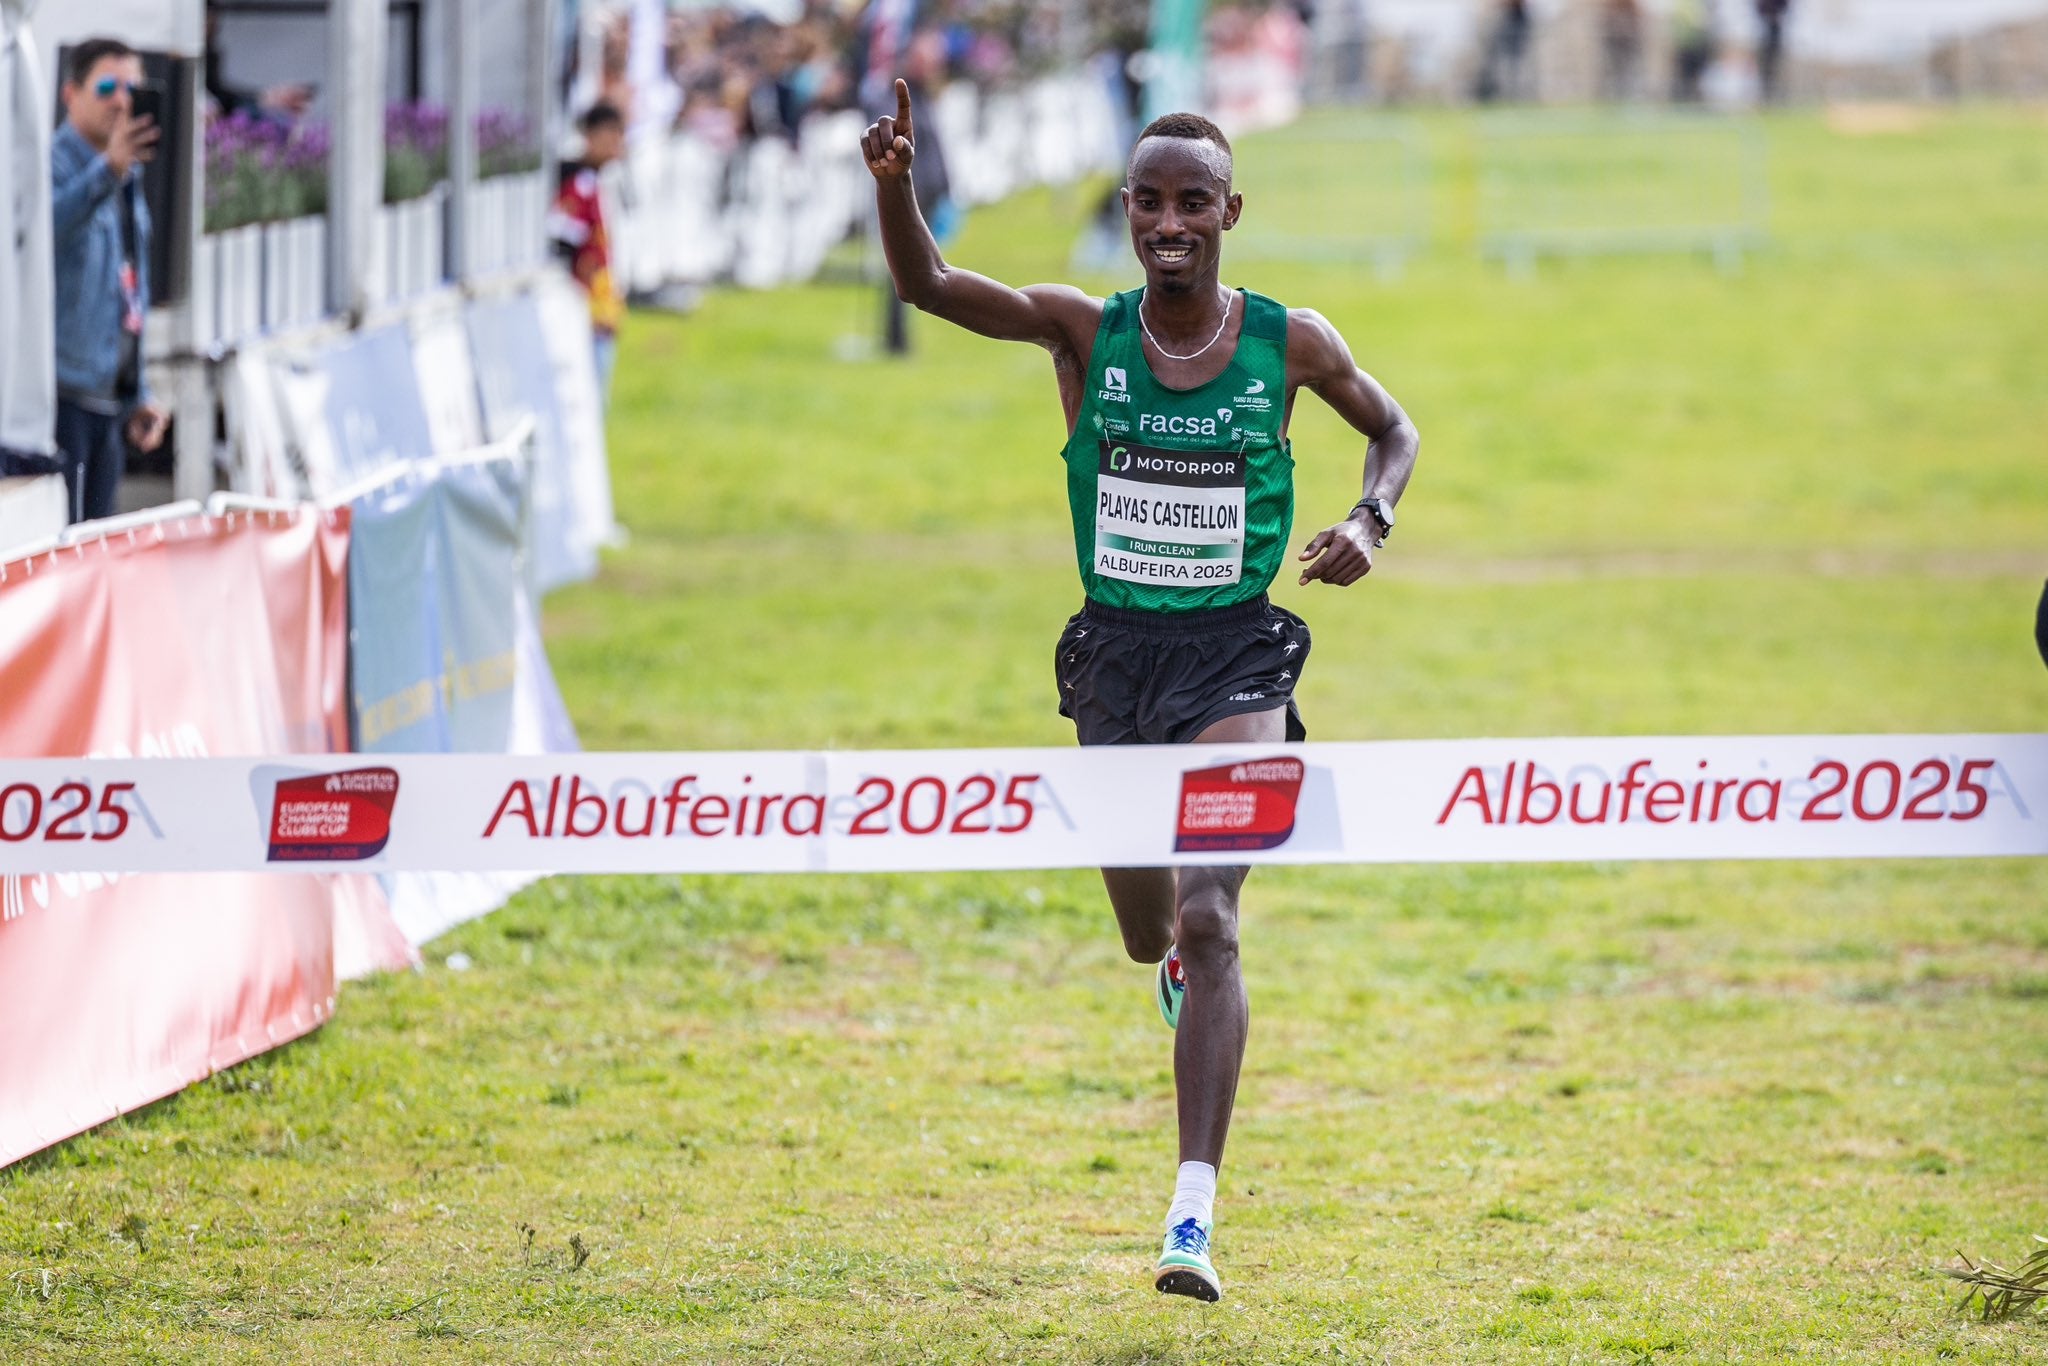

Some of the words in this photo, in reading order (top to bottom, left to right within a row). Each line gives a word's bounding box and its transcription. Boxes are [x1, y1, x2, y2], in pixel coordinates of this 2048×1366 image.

[1139, 413, 1217, 436] Facsa
[1137, 456, 1236, 475] MOTORPOR
[1099, 491, 1148, 524] PLAYAS
[1153, 501, 1238, 530] CASTELLON
[1129, 540, 1134, 550] I
[1134, 541, 1157, 553] RUN
[1099, 554, 1189, 579] ALBUFEIRA
[1193, 564, 1234, 579] 2025
[1436, 760, 1782, 826] Albufeira
[1800, 760, 1995, 823] 2025
[280, 802, 350, 813] EUROPEAN
[482, 774, 825, 838] Albufeira
[849, 774, 1040, 836] 2025
[279, 814, 349, 824] CHAMPION
[1224, 815, 1255, 828] CUP
[277, 824, 318, 836] CLUBS
[319, 824, 349, 836] CUP
